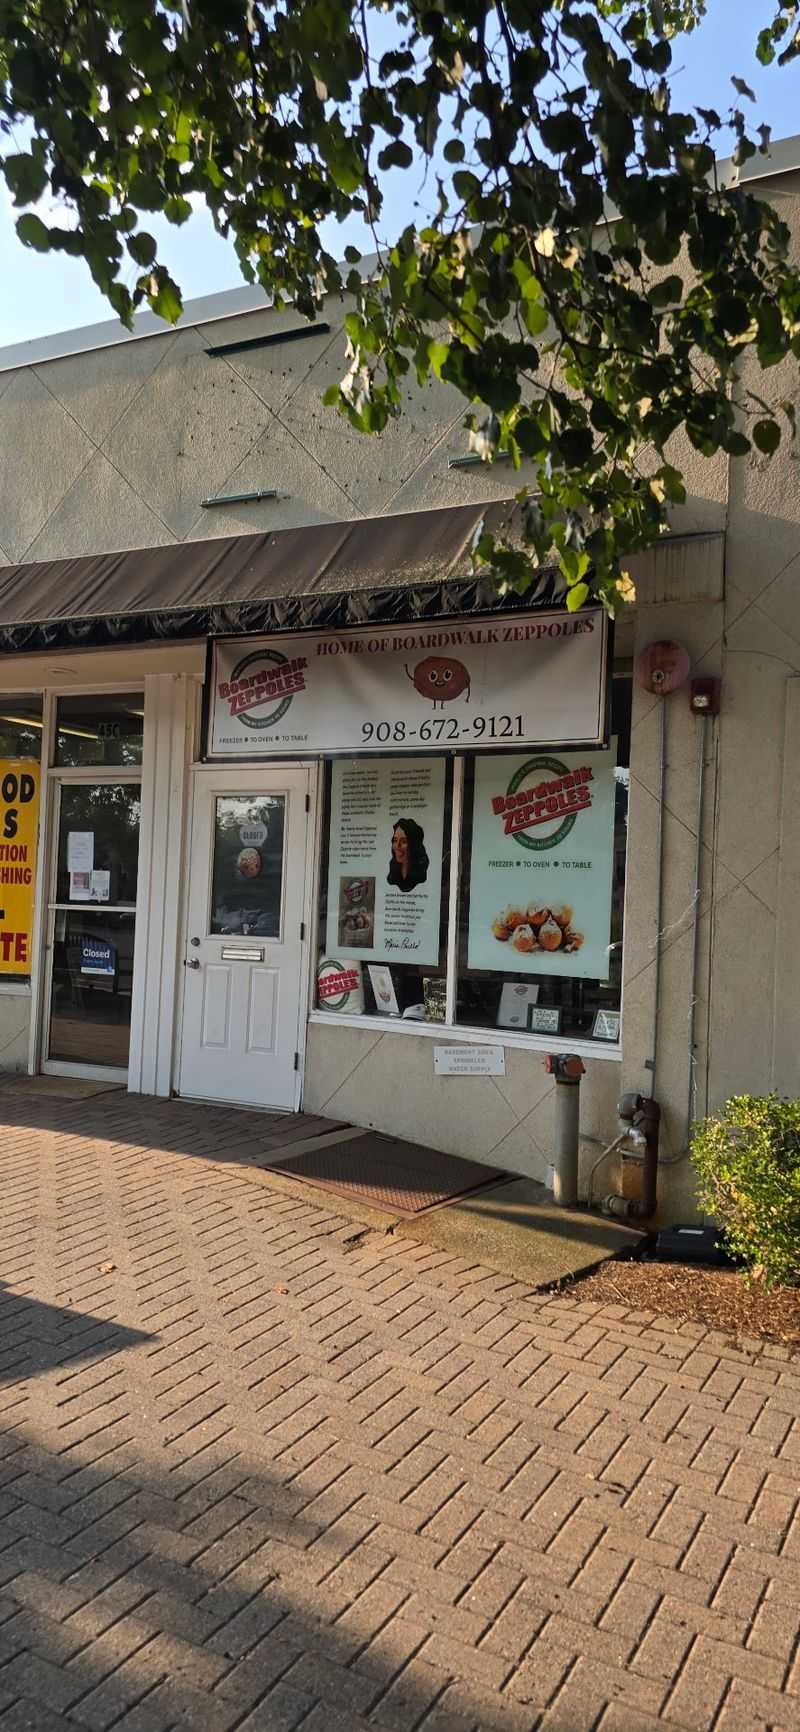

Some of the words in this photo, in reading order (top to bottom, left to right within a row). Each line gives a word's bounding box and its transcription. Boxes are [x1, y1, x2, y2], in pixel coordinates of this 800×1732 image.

[316, 640, 363, 655] HOME
[367, 638, 390, 653] OF
[392, 629, 499, 651] BOARDWALK
[502, 618, 594, 642] ZEPPOLES
[218, 657, 308, 699] Boardwalk
[228, 671, 305, 716] ZEPPOLES
[362, 715, 525, 742] 908-672-9121
[492, 767, 594, 815] Boardwalk
[502, 785, 592, 834] ZEPPOLES
[82, 948, 110, 959] Closed
